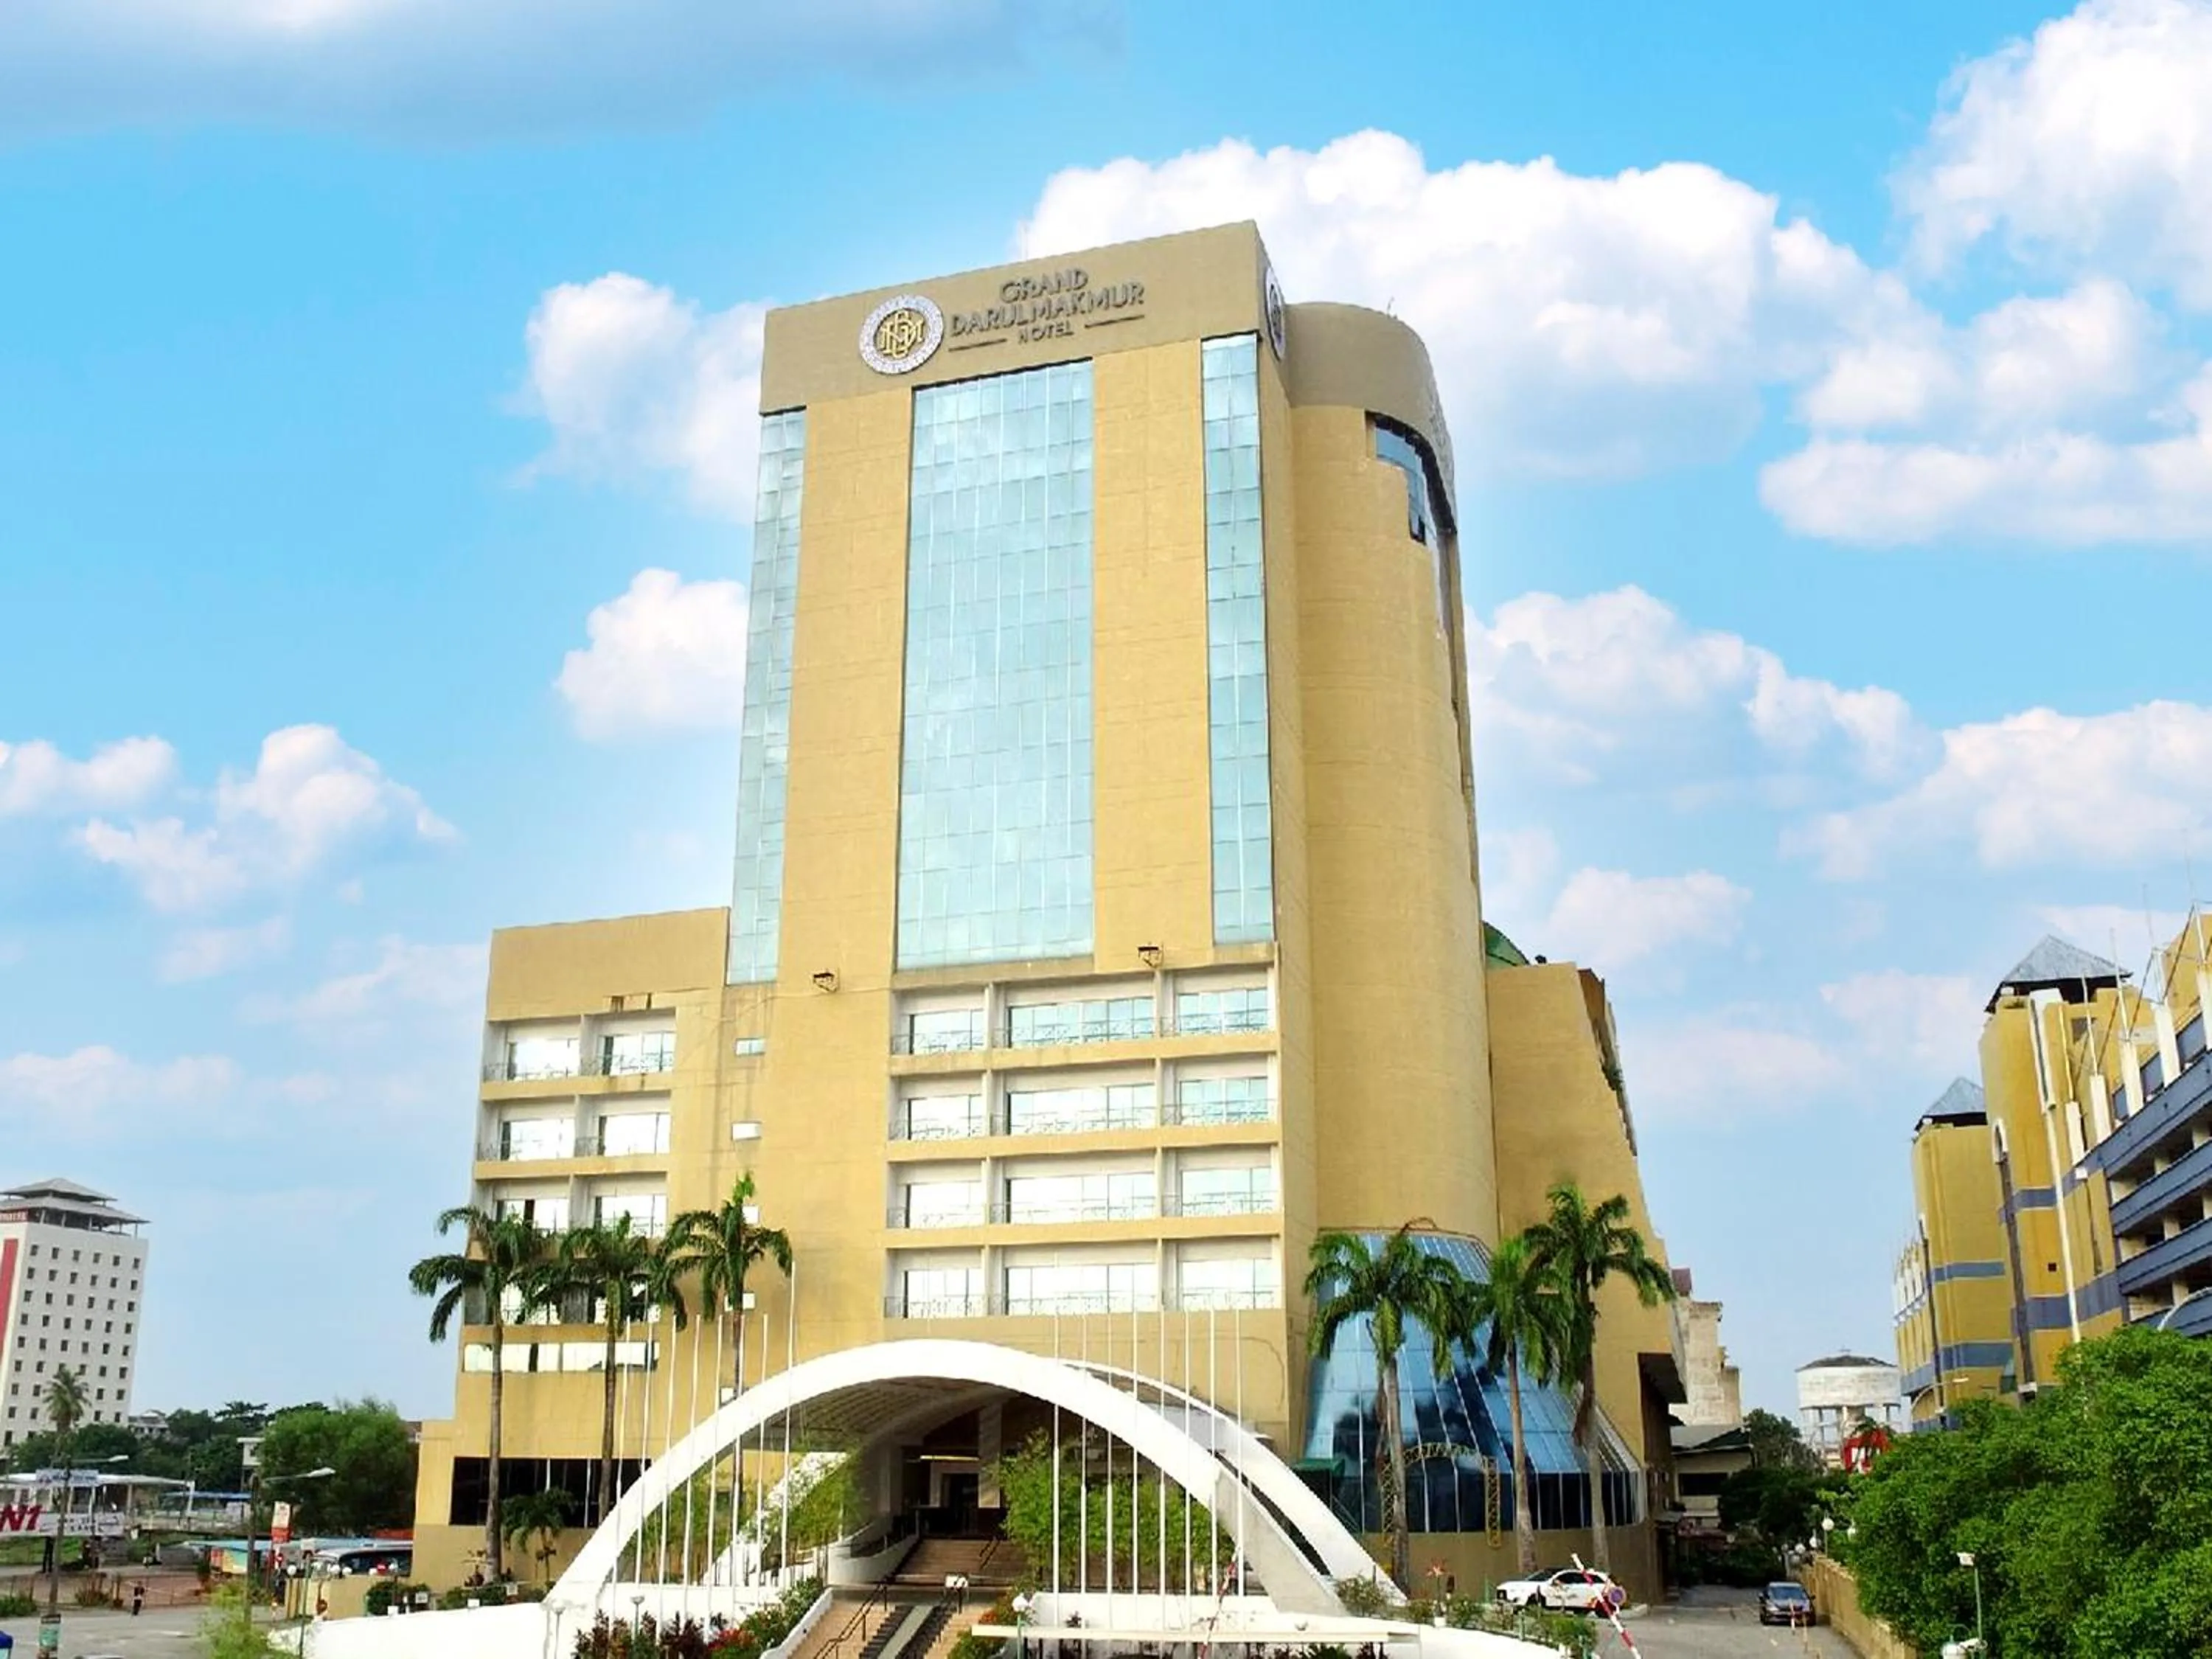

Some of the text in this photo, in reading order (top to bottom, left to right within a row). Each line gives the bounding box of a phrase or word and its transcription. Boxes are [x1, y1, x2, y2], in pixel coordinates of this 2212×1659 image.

[1001, 270, 1088, 303] GRAND
[950, 282, 1145, 336] DARULMAKMUR
[1018, 320, 1074, 344] HOTEL
